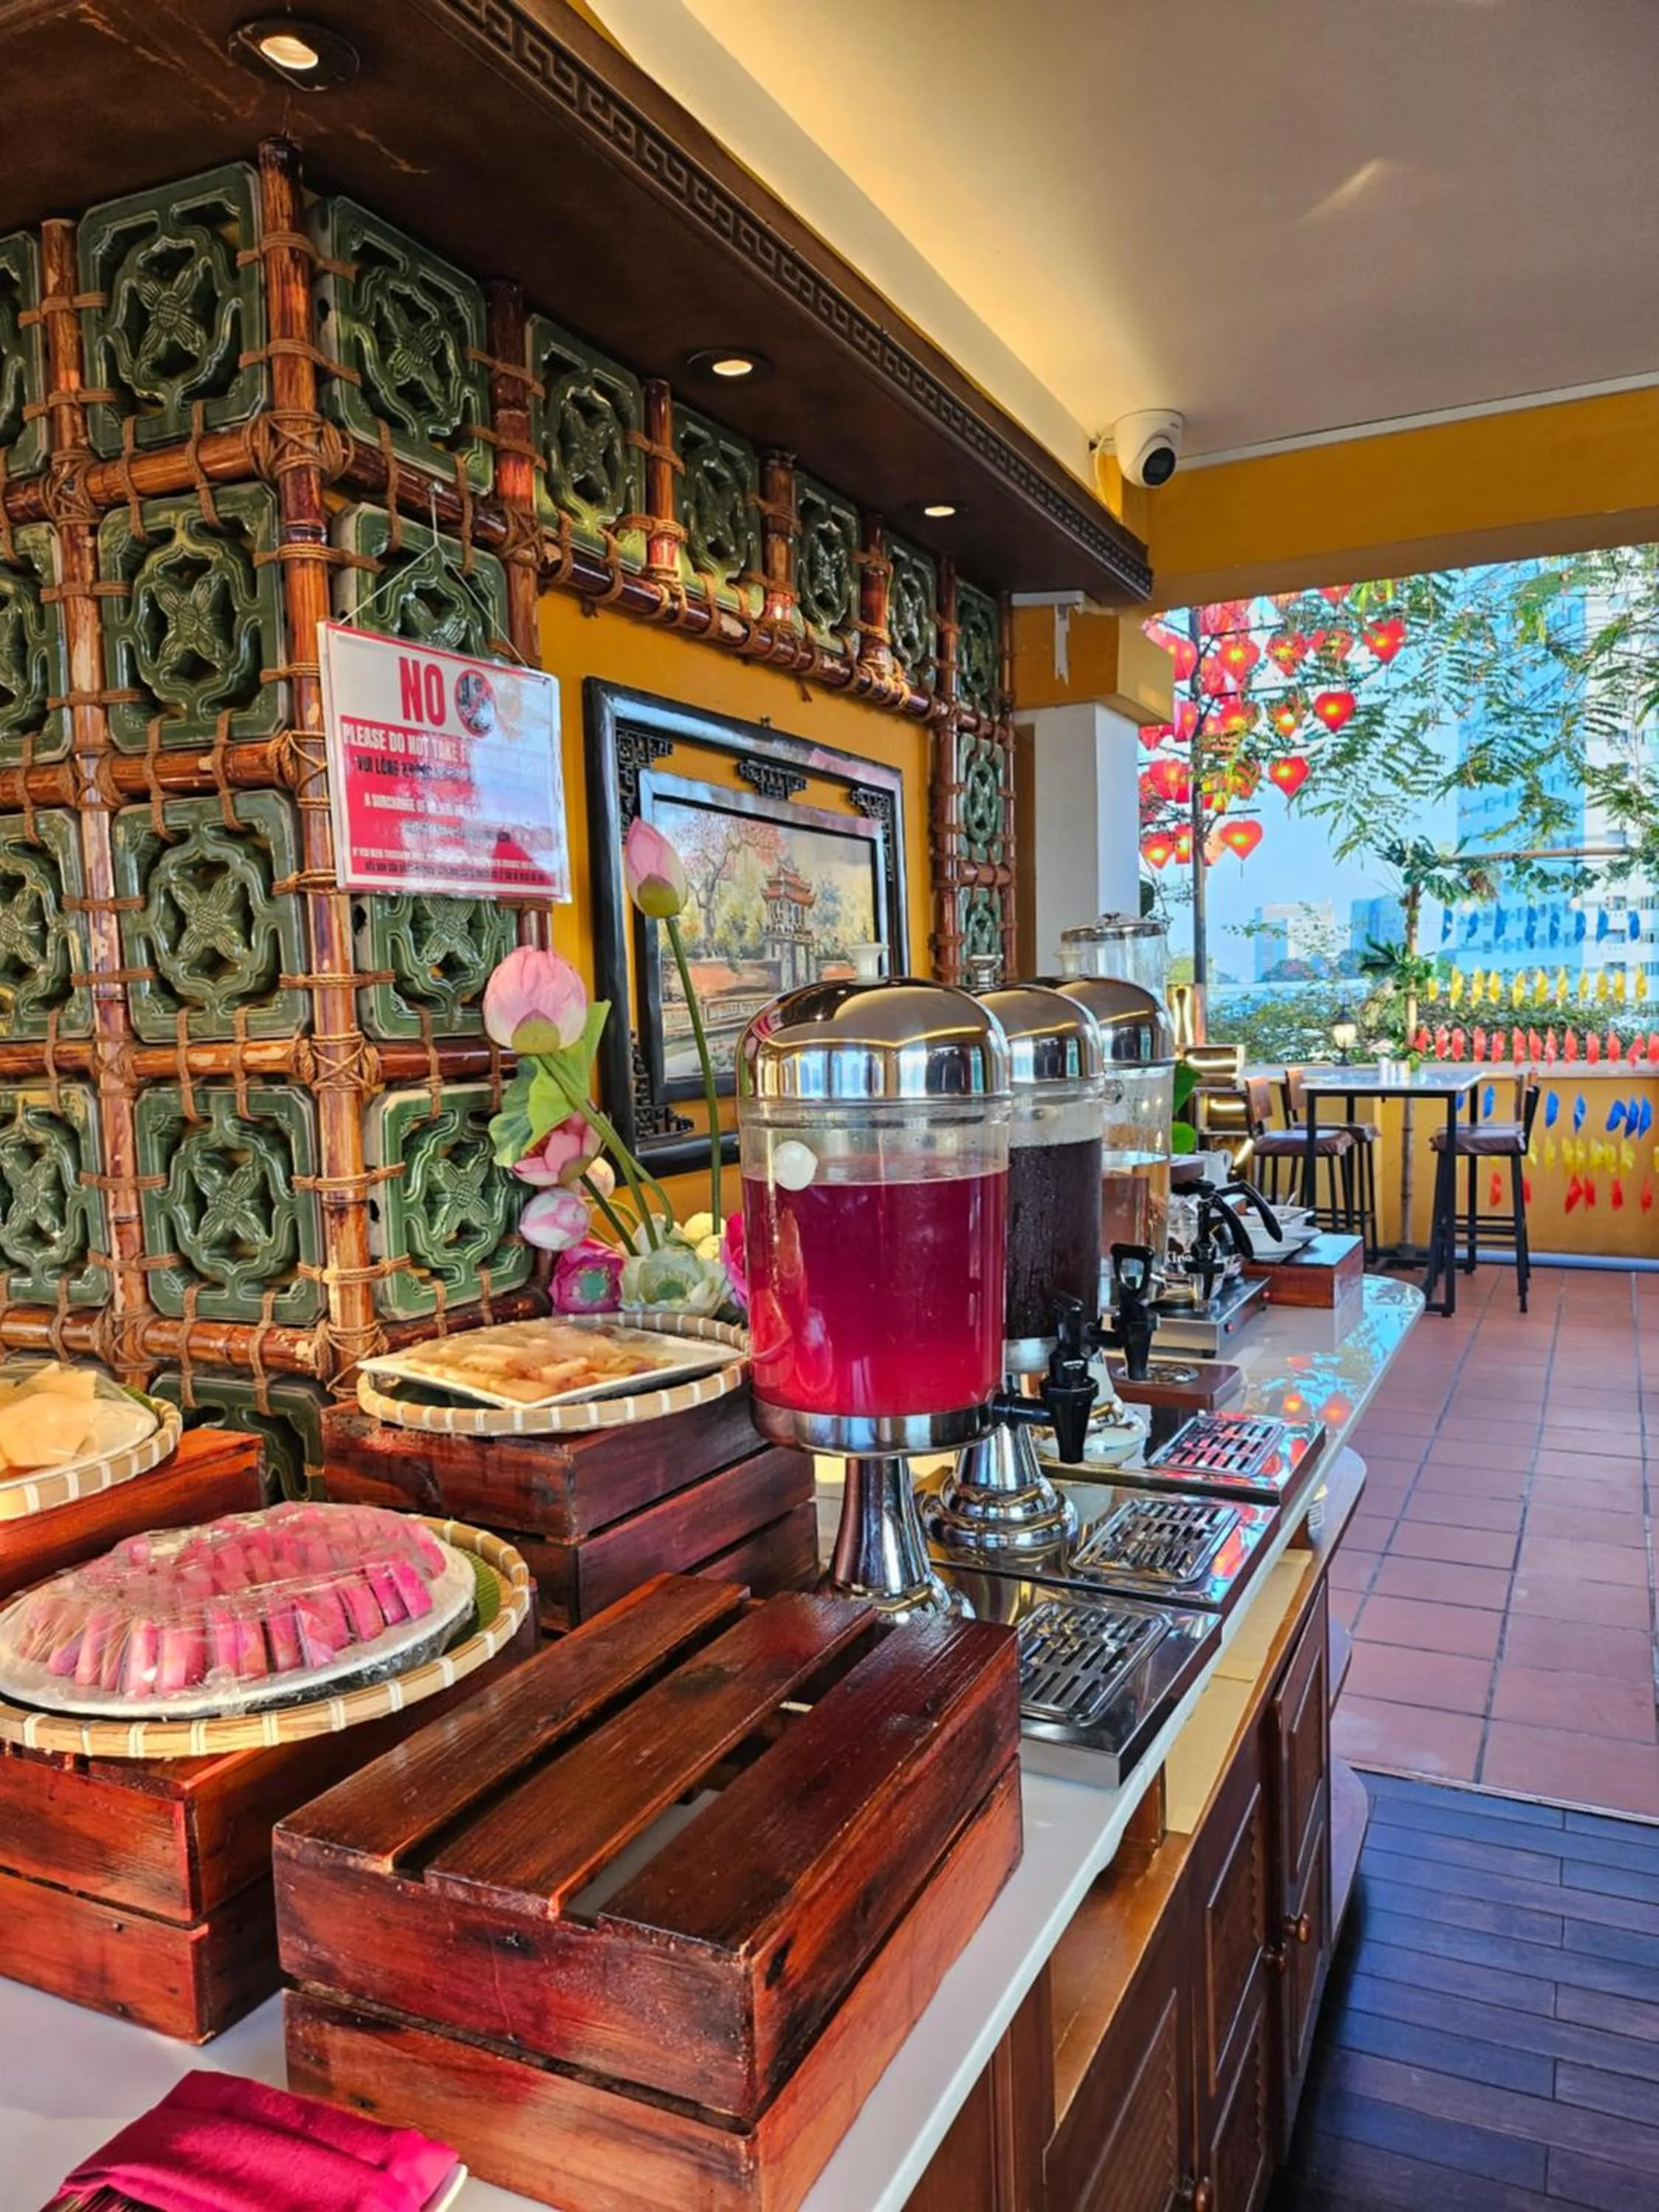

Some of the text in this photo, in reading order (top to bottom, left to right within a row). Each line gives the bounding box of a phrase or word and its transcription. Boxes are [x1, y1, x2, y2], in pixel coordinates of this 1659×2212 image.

[399, 656, 446, 727] NO
[341, 722, 386, 750] PLEASE
[388, 731, 406, 754] DO
[407, 734, 428, 757] NOT
